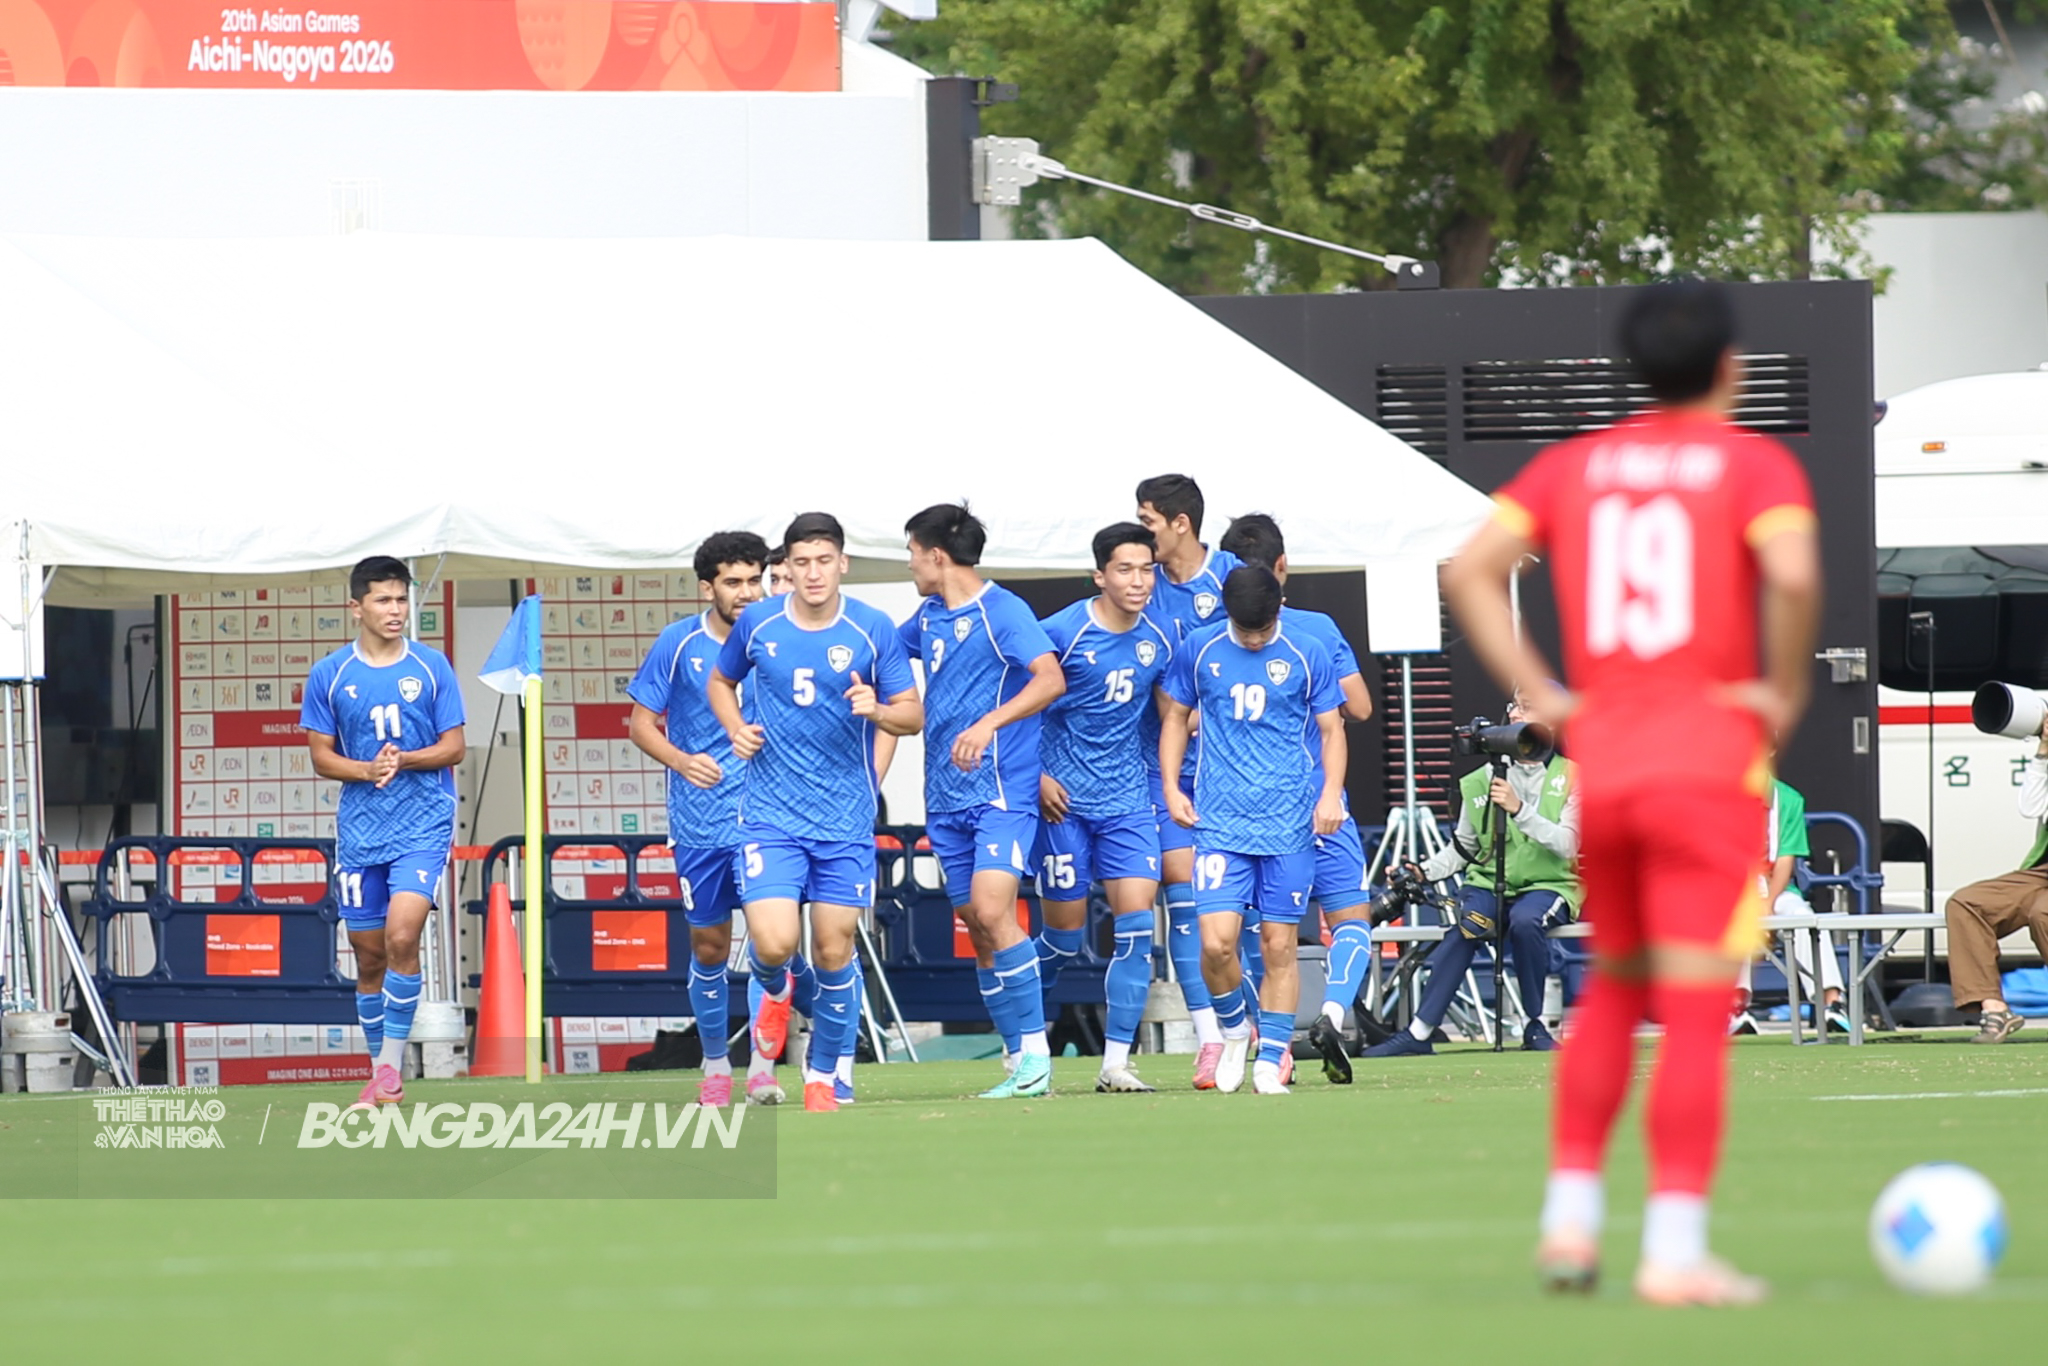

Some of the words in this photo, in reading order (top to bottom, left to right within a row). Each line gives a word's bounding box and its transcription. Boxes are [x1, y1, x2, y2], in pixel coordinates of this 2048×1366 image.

[221, 8, 257, 32] 20th
[260, 8, 302, 32] Asian
[305, 10, 360, 33] Games
[188, 36, 335, 82] Aichi-Nagoya
[340, 40, 394, 73] 2026
[1585, 492, 1696, 661] 19
[930, 638, 945, 673] 3
[792, 667, 816, 707] 5
[1104, 668, 1135, 703] 15
[1230, 683, 1267, 721] 19
[369, 703, 402, 741] 11
[745, 843, 764, 877] 5
[1042, 854, 1077, 889] 15
[1195, 853, 1227, 891] 19
[340, 871, 362, 908] 11
[680, 876, 696, 911] 8
[267, 1069, 297, 1080] IMAGINE
[298, 1069, 312, 1080] ONE
[313, 1068, 330, 1079] ASIA
